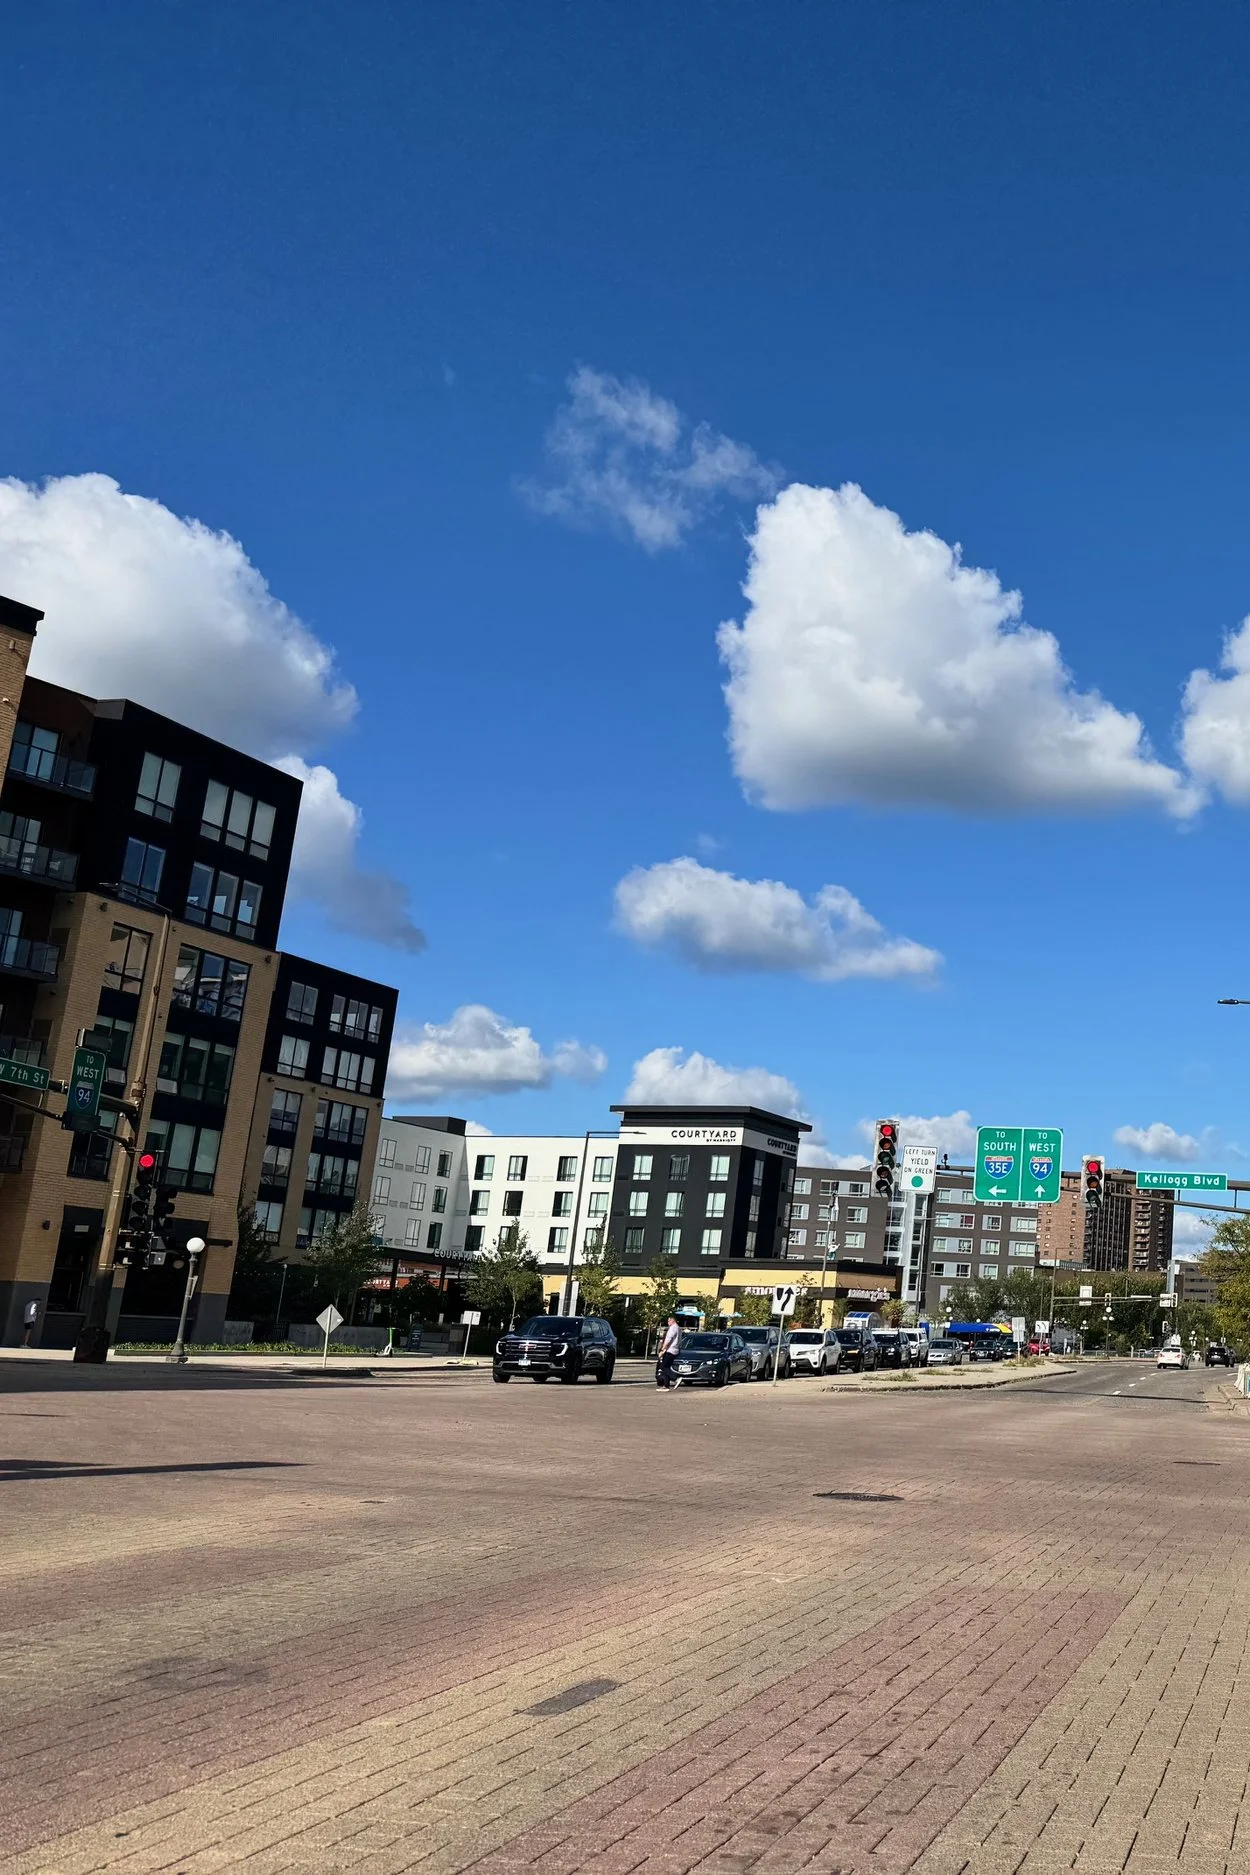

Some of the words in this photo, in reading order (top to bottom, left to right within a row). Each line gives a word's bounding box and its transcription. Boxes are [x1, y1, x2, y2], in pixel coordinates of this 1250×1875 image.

[86, 1055, 94, 1064] TO
[10, 1067, 28, 1081] 7th
[33, 1072, 45, 1085] St
[76, 1065, 99, 1080] WEST
[78, 1089, 90, 1103] 94
[671, 1130, 737, 1138] COURTYARD
[995, 1131, 1006, 1139] TO
[1037, 1132, 1048, 1140] TO
[983, 1142, 1017, 1152] SOUTH
[1029, 1143, 1056, 1153] WEST
[910, 1157, 929, 1166] YIELD
[914, 1167, 933, 1175] GREEN
[988, 1162, 1008, 1174] 35E
[1032, 1163, 1048, 1175] 94
[1144, 1174, 1188, 1187] Kellogg
[1193, 1175, 1220, 1186] Blvd
